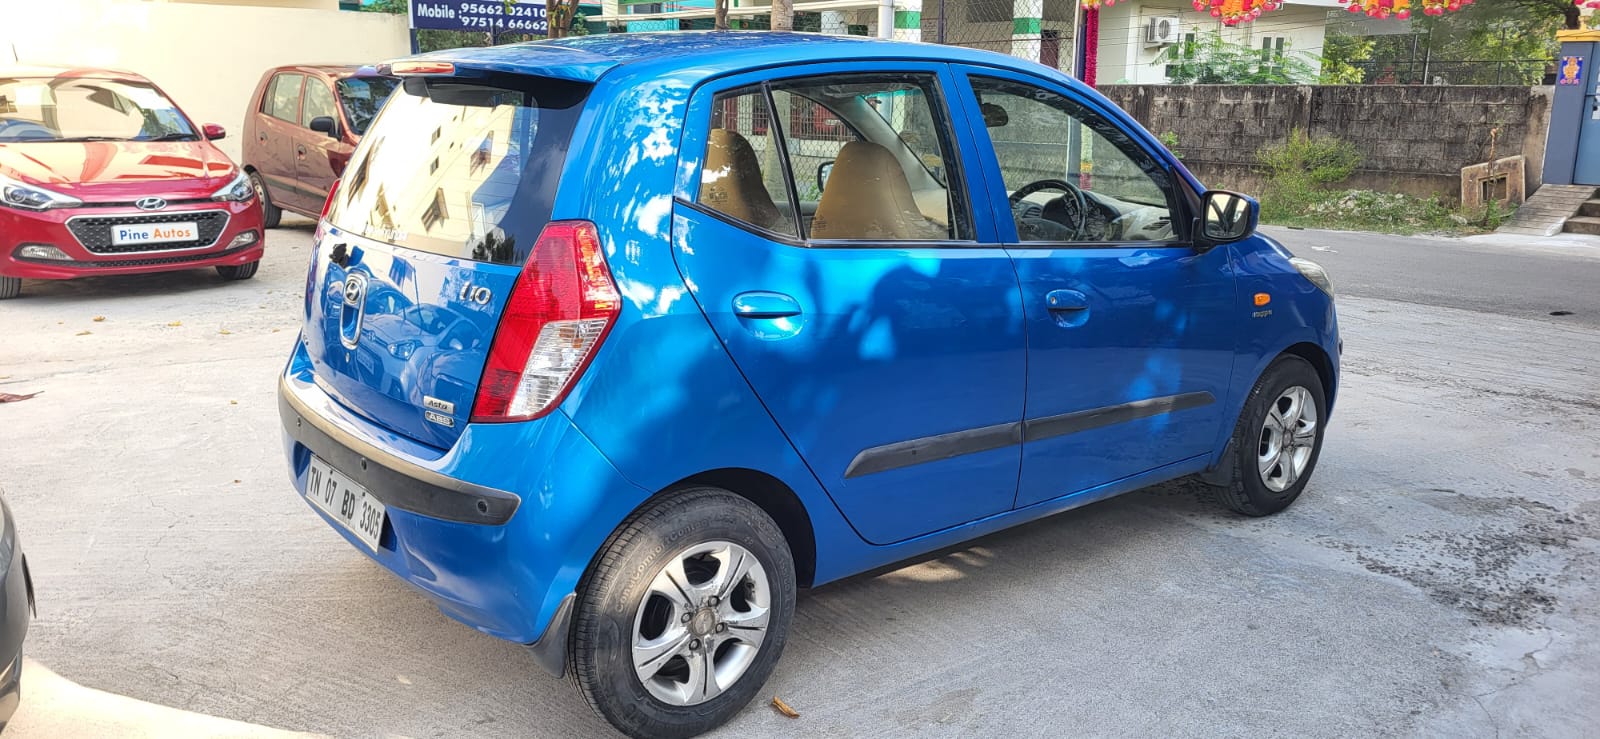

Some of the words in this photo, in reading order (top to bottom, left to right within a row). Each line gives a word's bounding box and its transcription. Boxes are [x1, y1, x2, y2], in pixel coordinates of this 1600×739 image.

[417, 3, 455, 19] Mobile
[461, 3, 503, 15] 95662
[508, 6, 546, 18] 02410
[461, 16, 504, 28] 97514
[508, 19, 547, 30] 66662
[120, 228, 149, 240] Pine
[154, 228, 191, 239] Autos
[428, 400, 448, 410] Asta
[310, 466, 322, 496] TN
[325, 477, 337, 507] 07
[341, 488, 355, 520] BD
[360, 501, 381, 539] 3305
